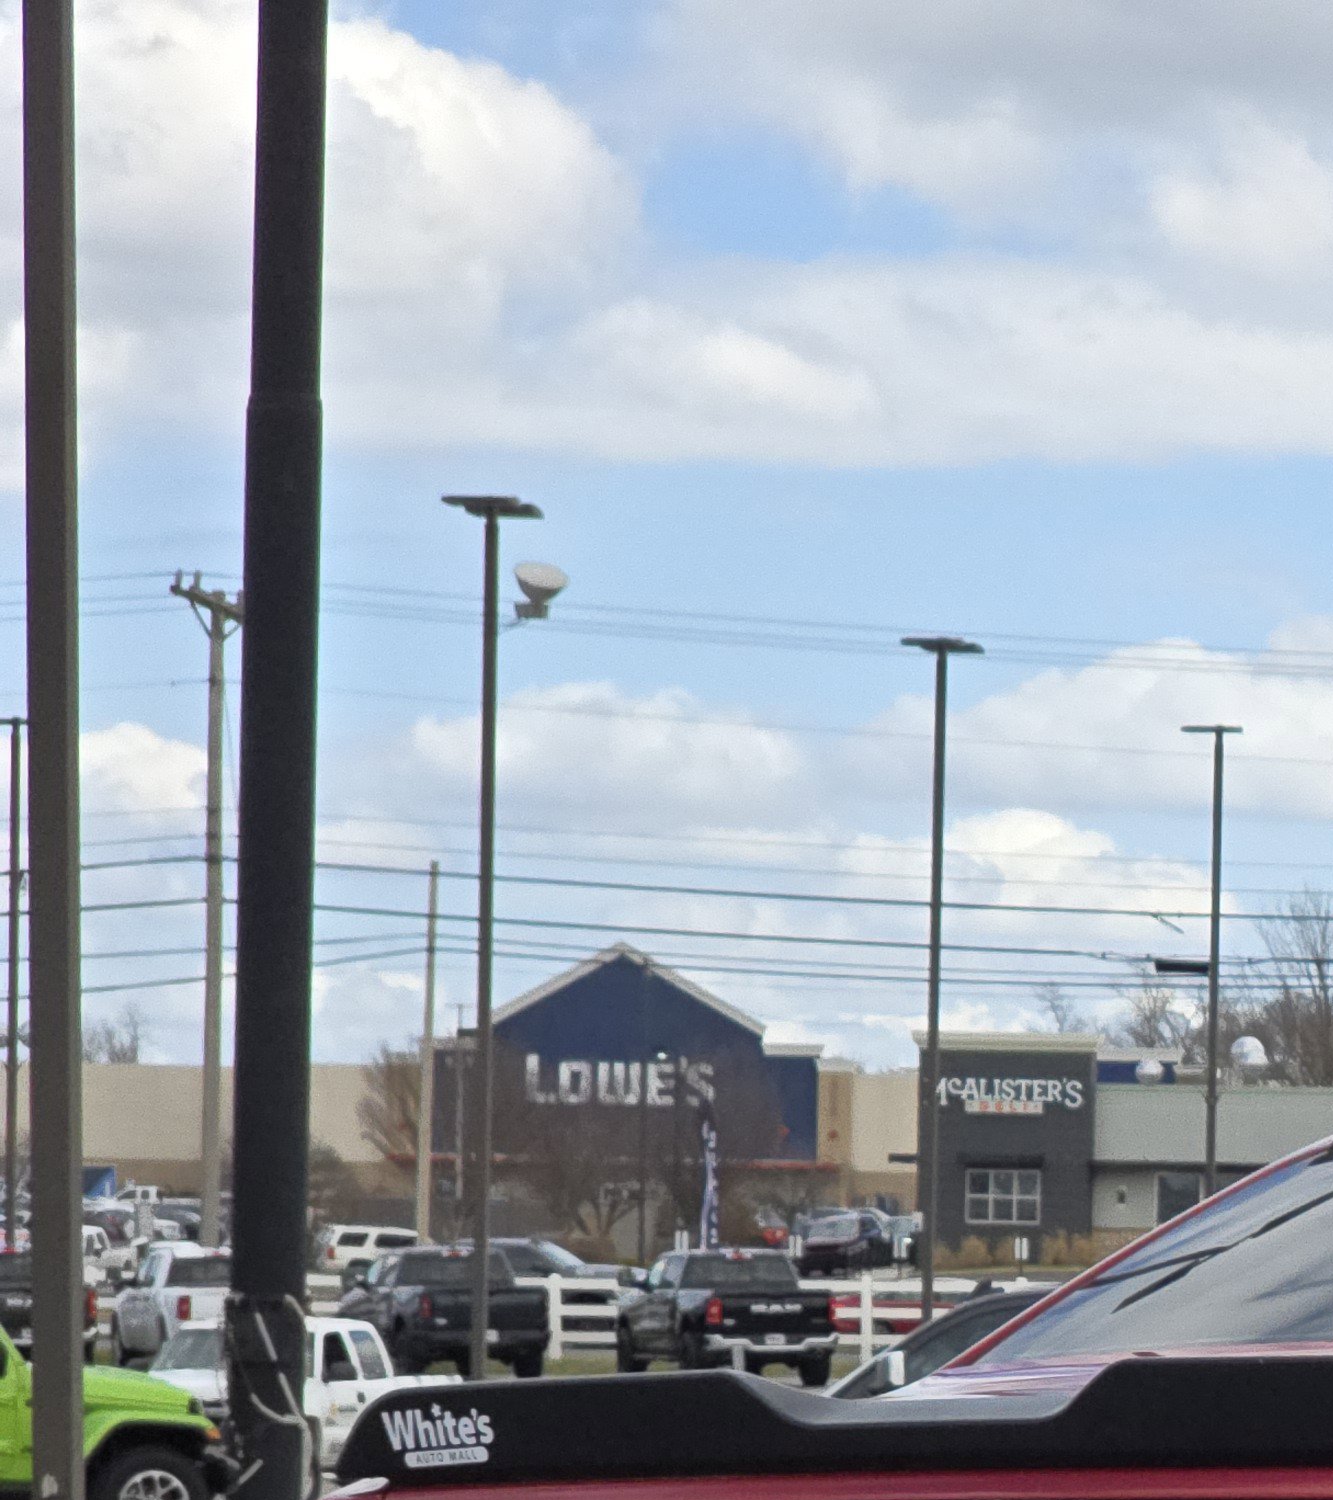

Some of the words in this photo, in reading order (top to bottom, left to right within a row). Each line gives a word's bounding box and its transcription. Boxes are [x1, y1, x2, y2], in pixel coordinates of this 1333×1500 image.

[525, 1053, 716, 1106] LOWE'S
[381, 1403, 495, 1451] White's
[416, 1453, 444, 1464] AUTO
[448, 1449, 478, 1461] MALL
